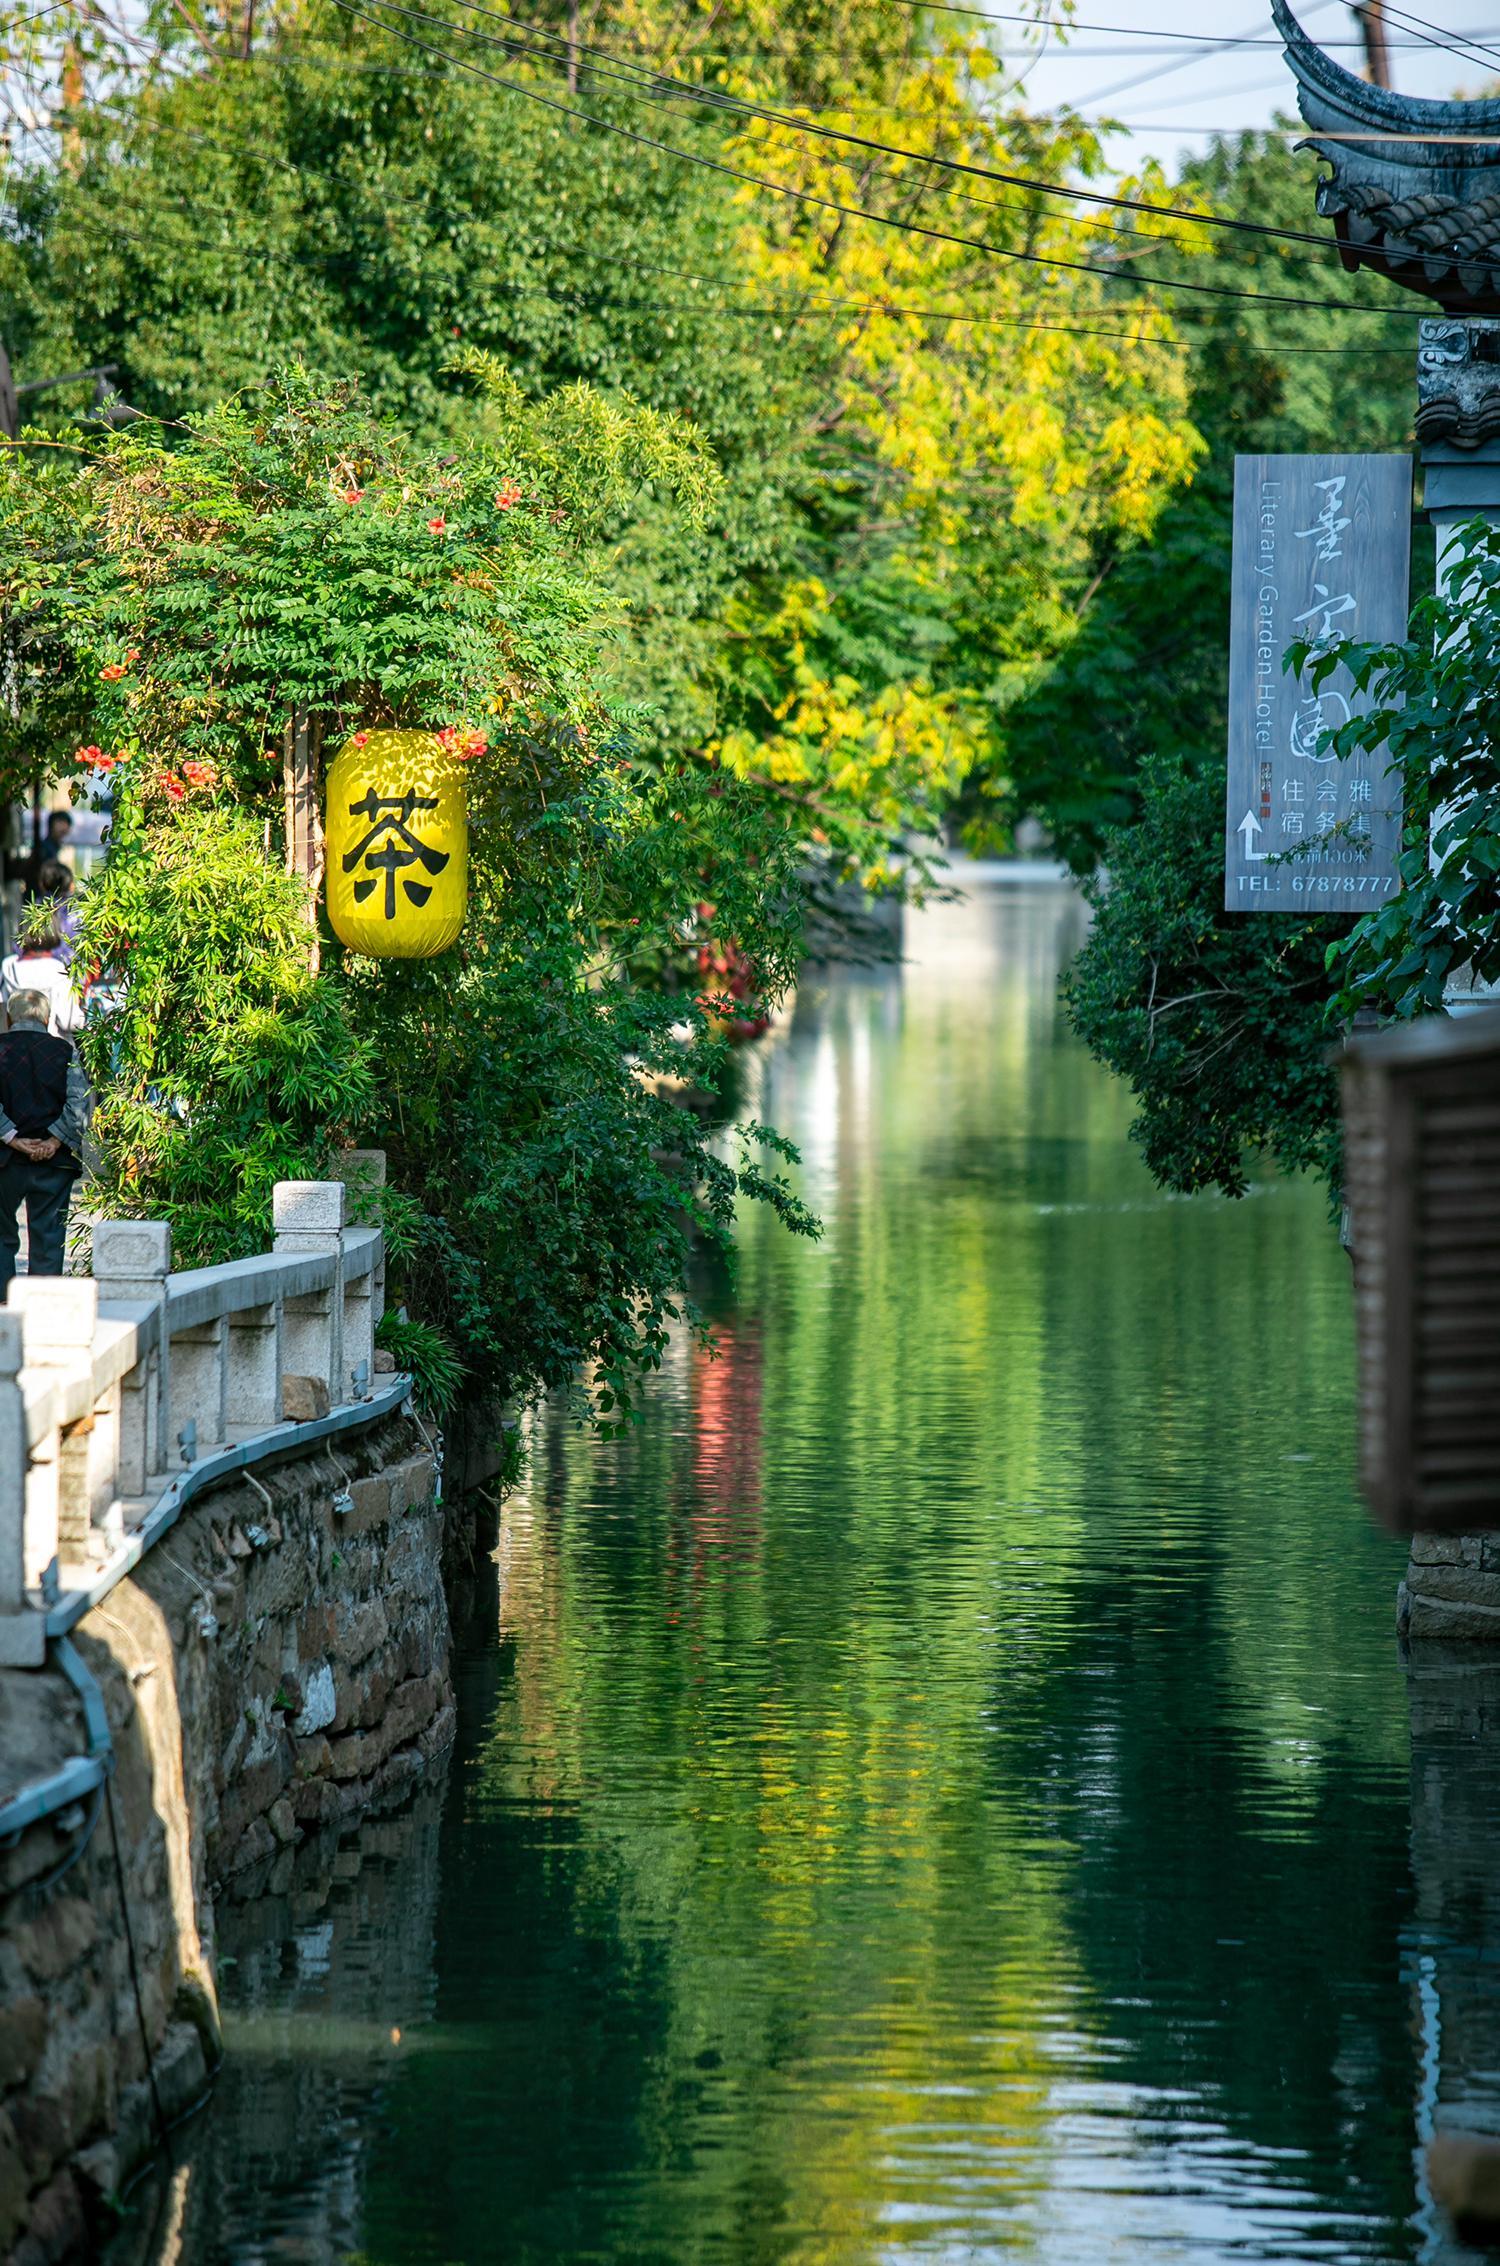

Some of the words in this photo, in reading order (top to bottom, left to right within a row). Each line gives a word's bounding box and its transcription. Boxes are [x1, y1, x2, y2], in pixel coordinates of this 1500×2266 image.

[1254, 481, 1281, 577] Literary
[1257, 585, 1279, 675] Garden
[1255, 684, 1276, 749] Hotel
[1281, 778, 1304, 834] 住宿
[1315, 778, 1338, 834] 会务
[1349, 778, 1372, 834] 雅集
[342, 787, 450, 920] 茶
[1236, 875, 1281, 892] TEL:
[1291, 875, 1393, 893] 67878777
